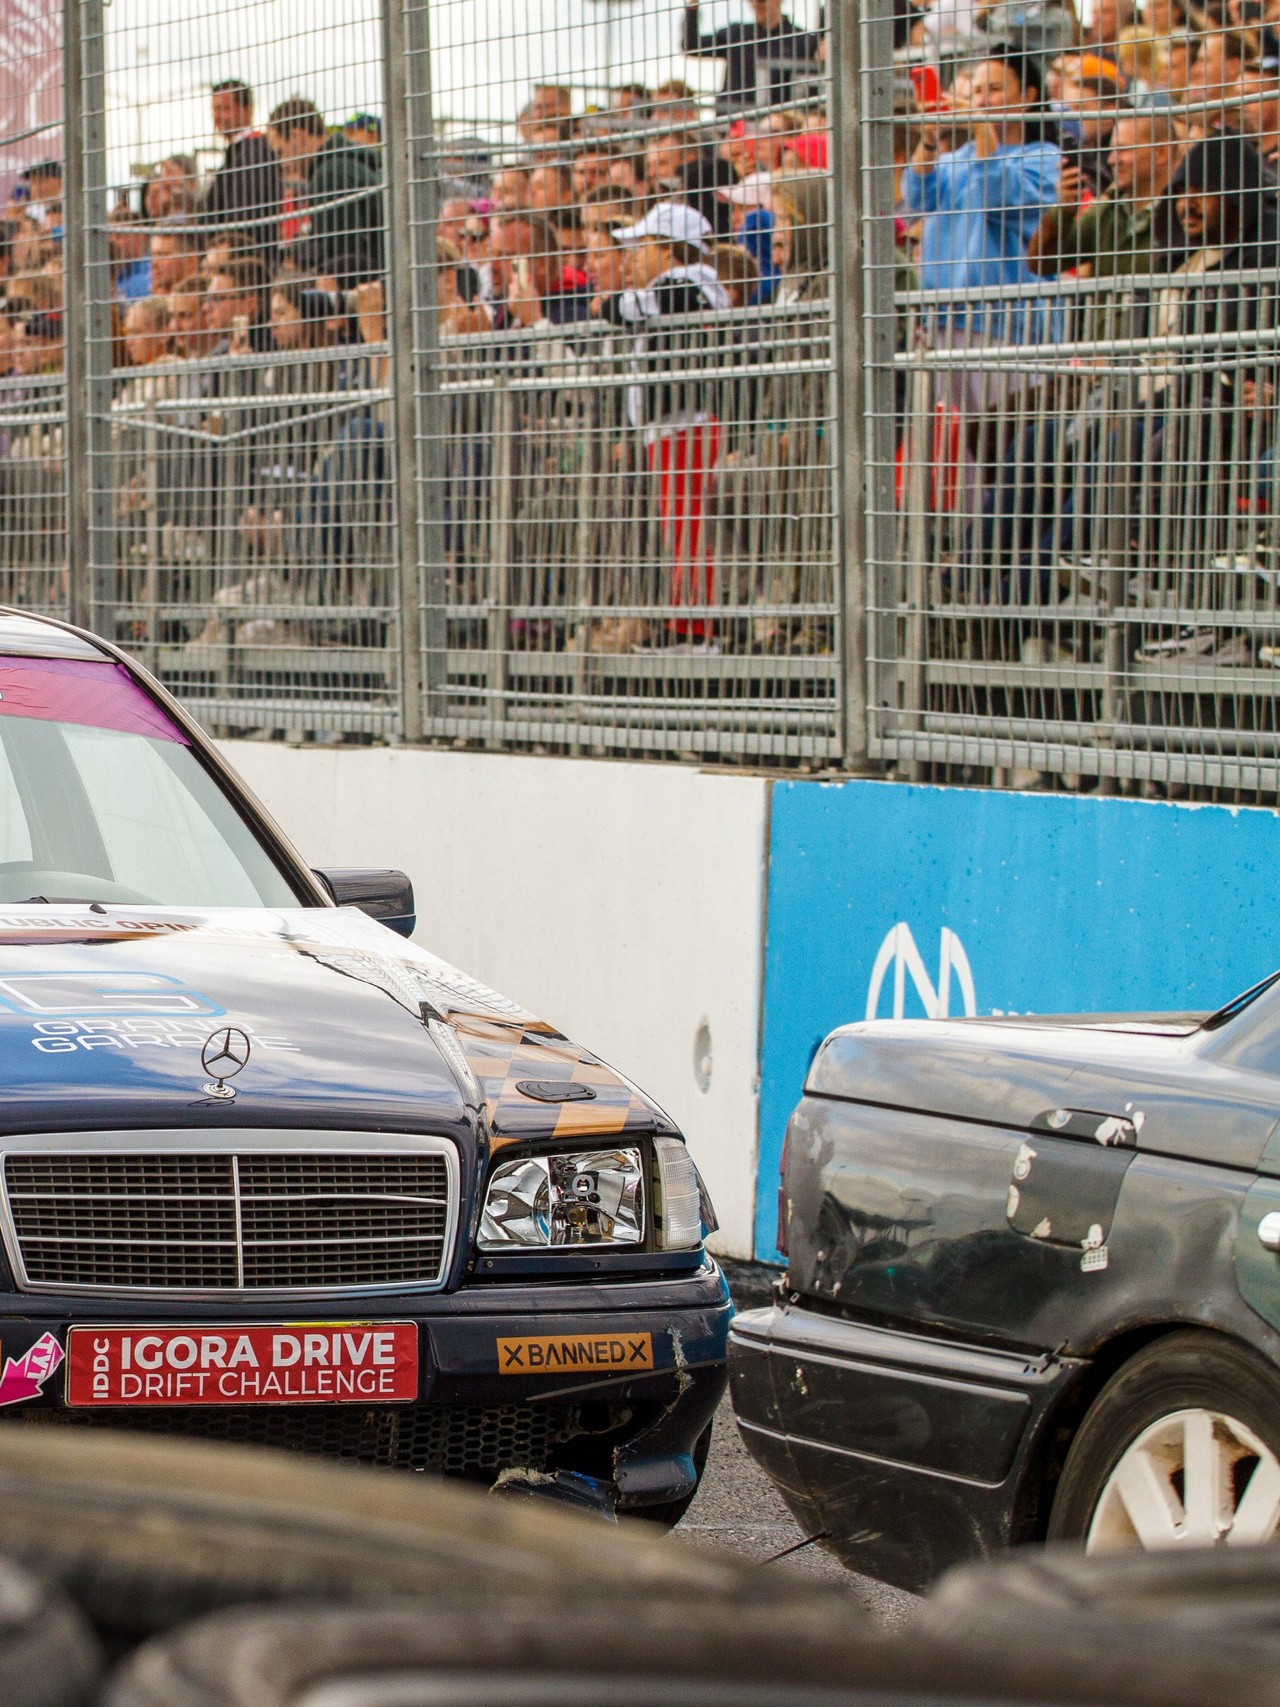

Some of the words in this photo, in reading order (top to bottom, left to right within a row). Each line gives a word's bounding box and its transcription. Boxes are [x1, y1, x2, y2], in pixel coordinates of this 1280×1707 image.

[33, 1019, 255, 1035] GRAND
[31, 1034, 301, 1053] GARAGE
[121, 1336, 259, 1370] IGORA
[272, 1332, 396, 1367] DRIVE
[93, 1338, 110, 1398] IDDC
[121, 1372, 211, 1399] DRIFT
[218, 1369, 396, 1397] CHALLENGE
